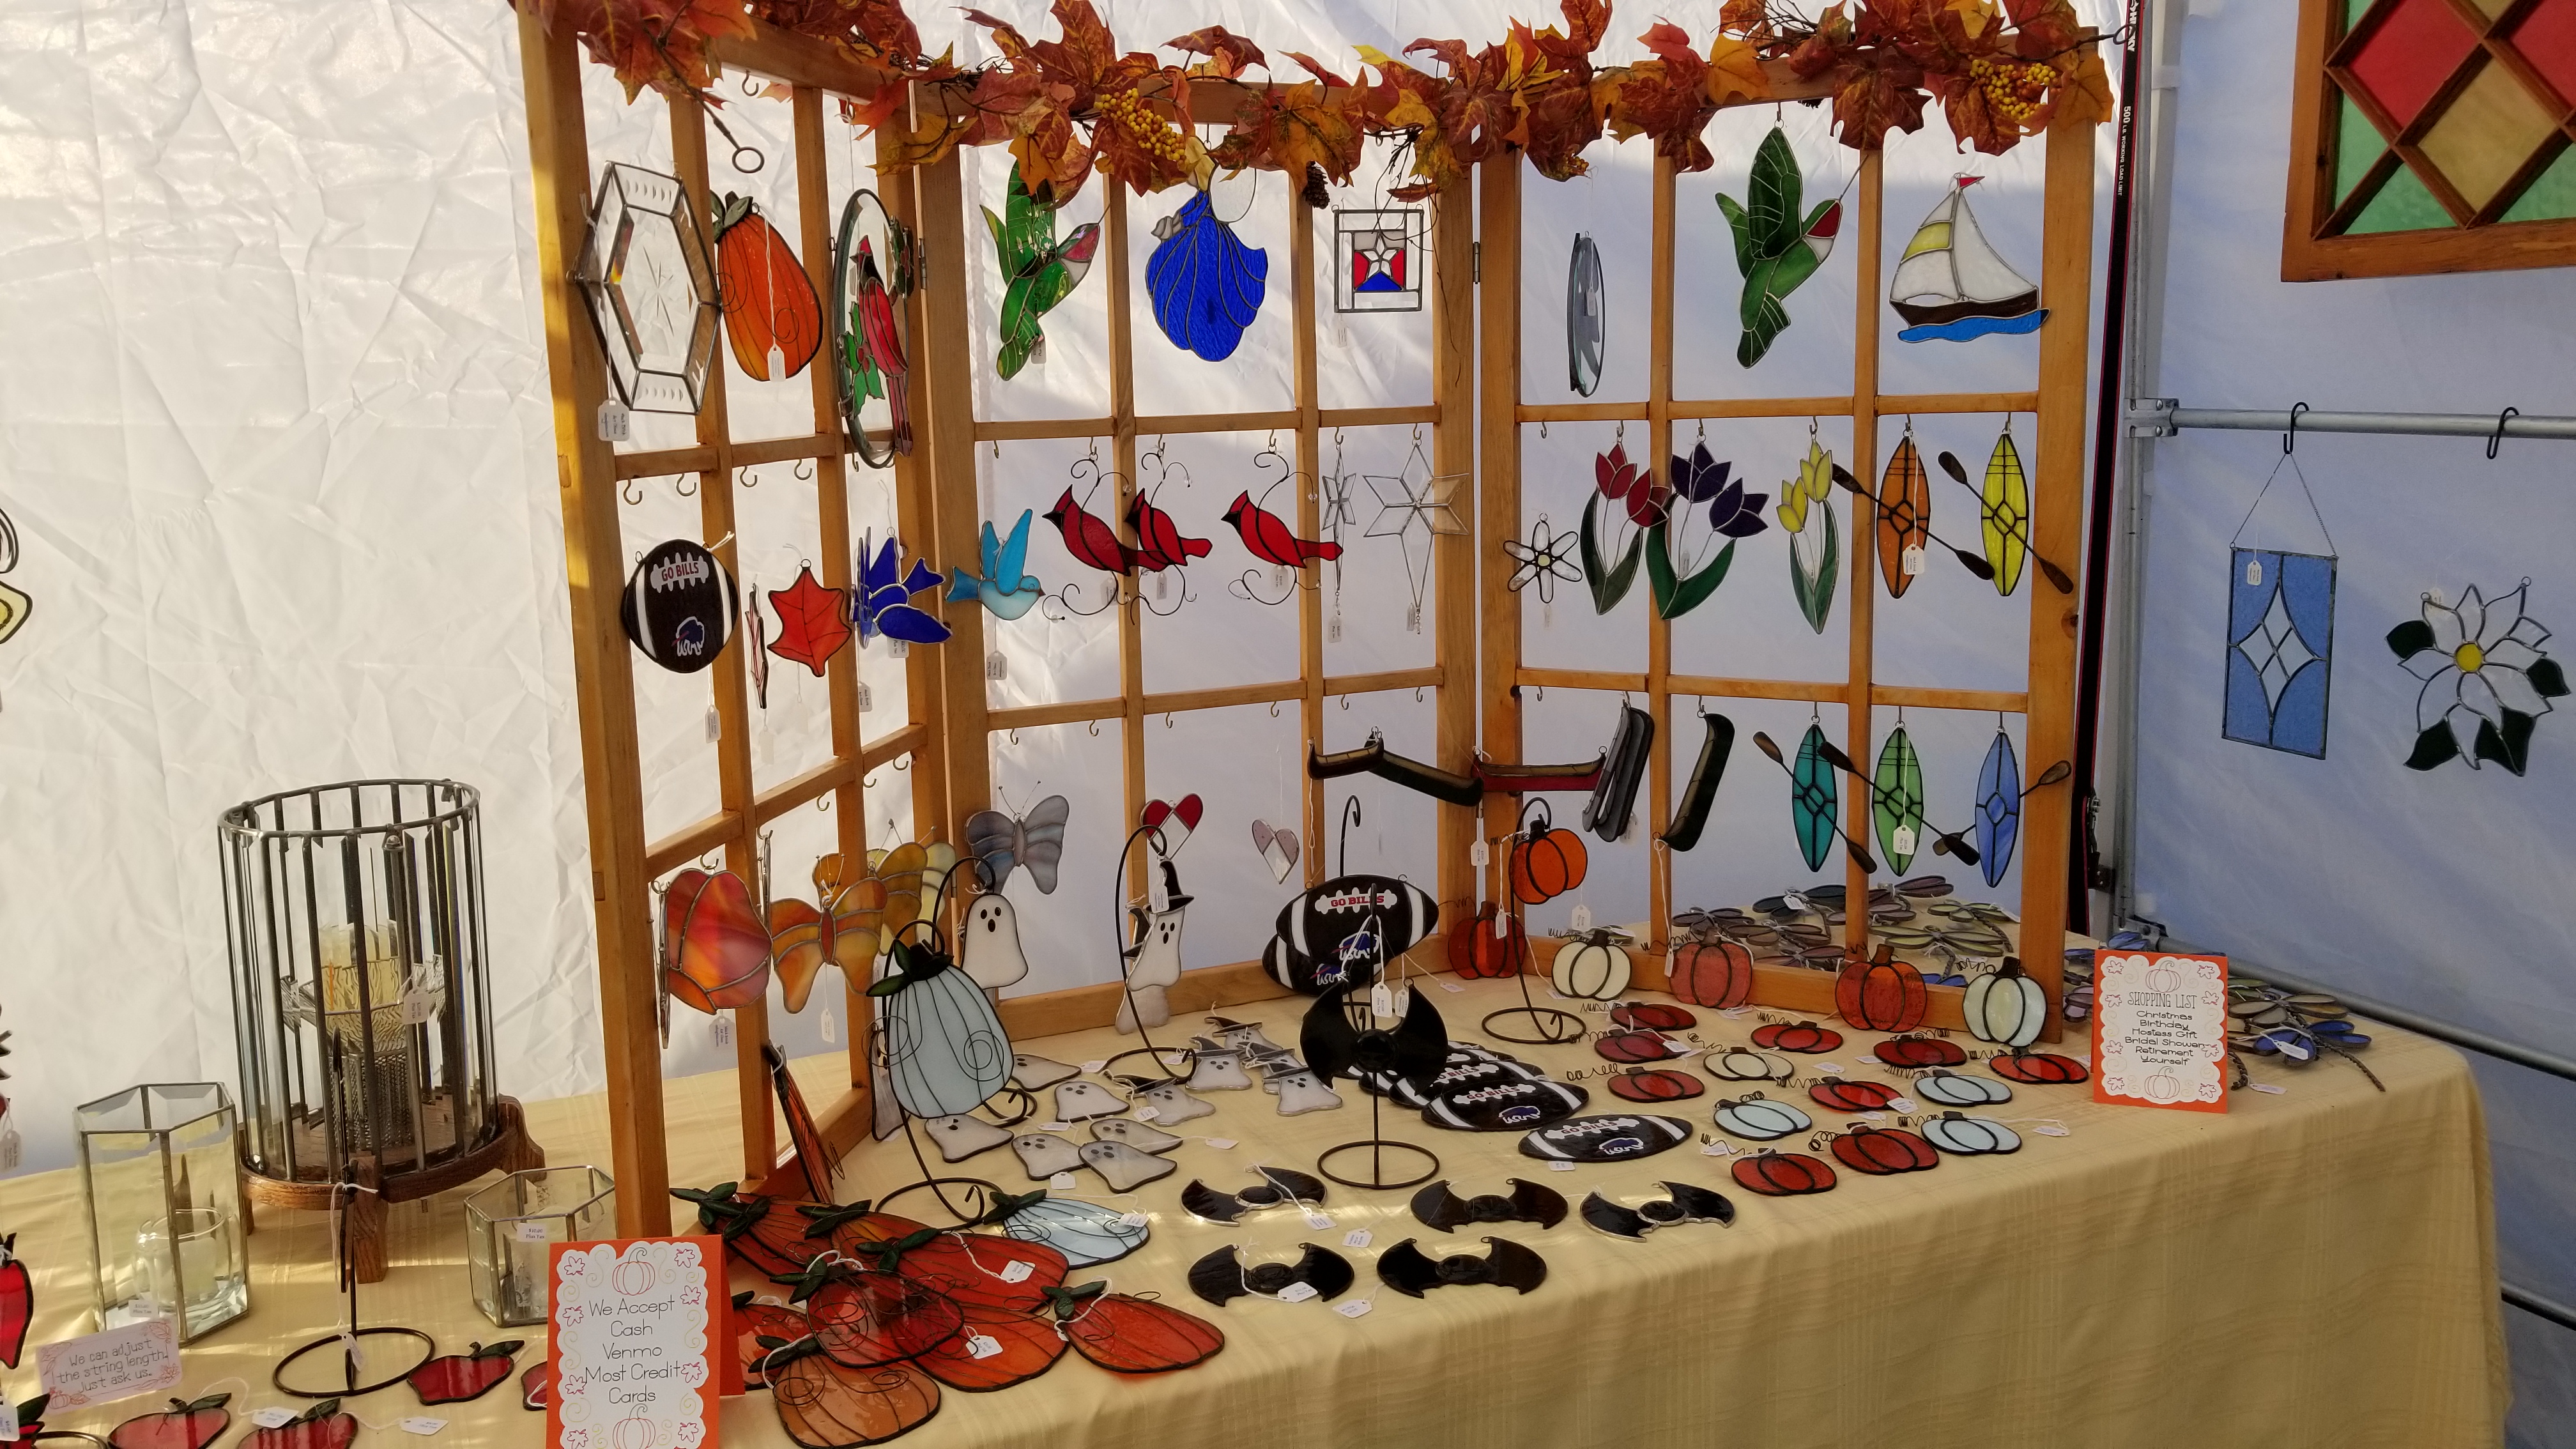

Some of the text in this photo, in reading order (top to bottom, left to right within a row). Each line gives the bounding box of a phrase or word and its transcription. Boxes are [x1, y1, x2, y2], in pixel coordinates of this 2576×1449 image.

[2123, 106, 2131, 123] 500
[661, 562, 699, 581] GO BILLS
[1331, 896, 1384, 907] GO BILS
[2128, 992, 2196, 1009] SHOPPING LIST
[2136, 1011, 2192, 1020] Christmas
[2132, 1028, 2172, 1037] Hostess
[2140, 1020, 2189, 1031] Birthday
[2125, 1037, 2205, 1048] Bridal Shower
[2135, 1046, 2193, 1057] Retirement
[2140, 1055, 2190, 1066] Yourself
[1447, 1067, 1480, 1077] BILLS
[1485, 1087, 1520, 1096] BILLS
[1581, 1122, 1617, 1130] BILLS
[589, 1294, 675, 1319] We Accept
[611, 1318, 653, 1337] Cash
[70, 1338, 153, 1367] We can adjust
[602, 1342, 662, 1360] Venmo
[57, 1371, 80, 1383] the
[84, 1361, 123, 1377] string
[78, 1368, 152, 1393] just ask us.
[585, 1360, 680, 1384] Most Credit
[609, 1385, 656, 1404] Cards
